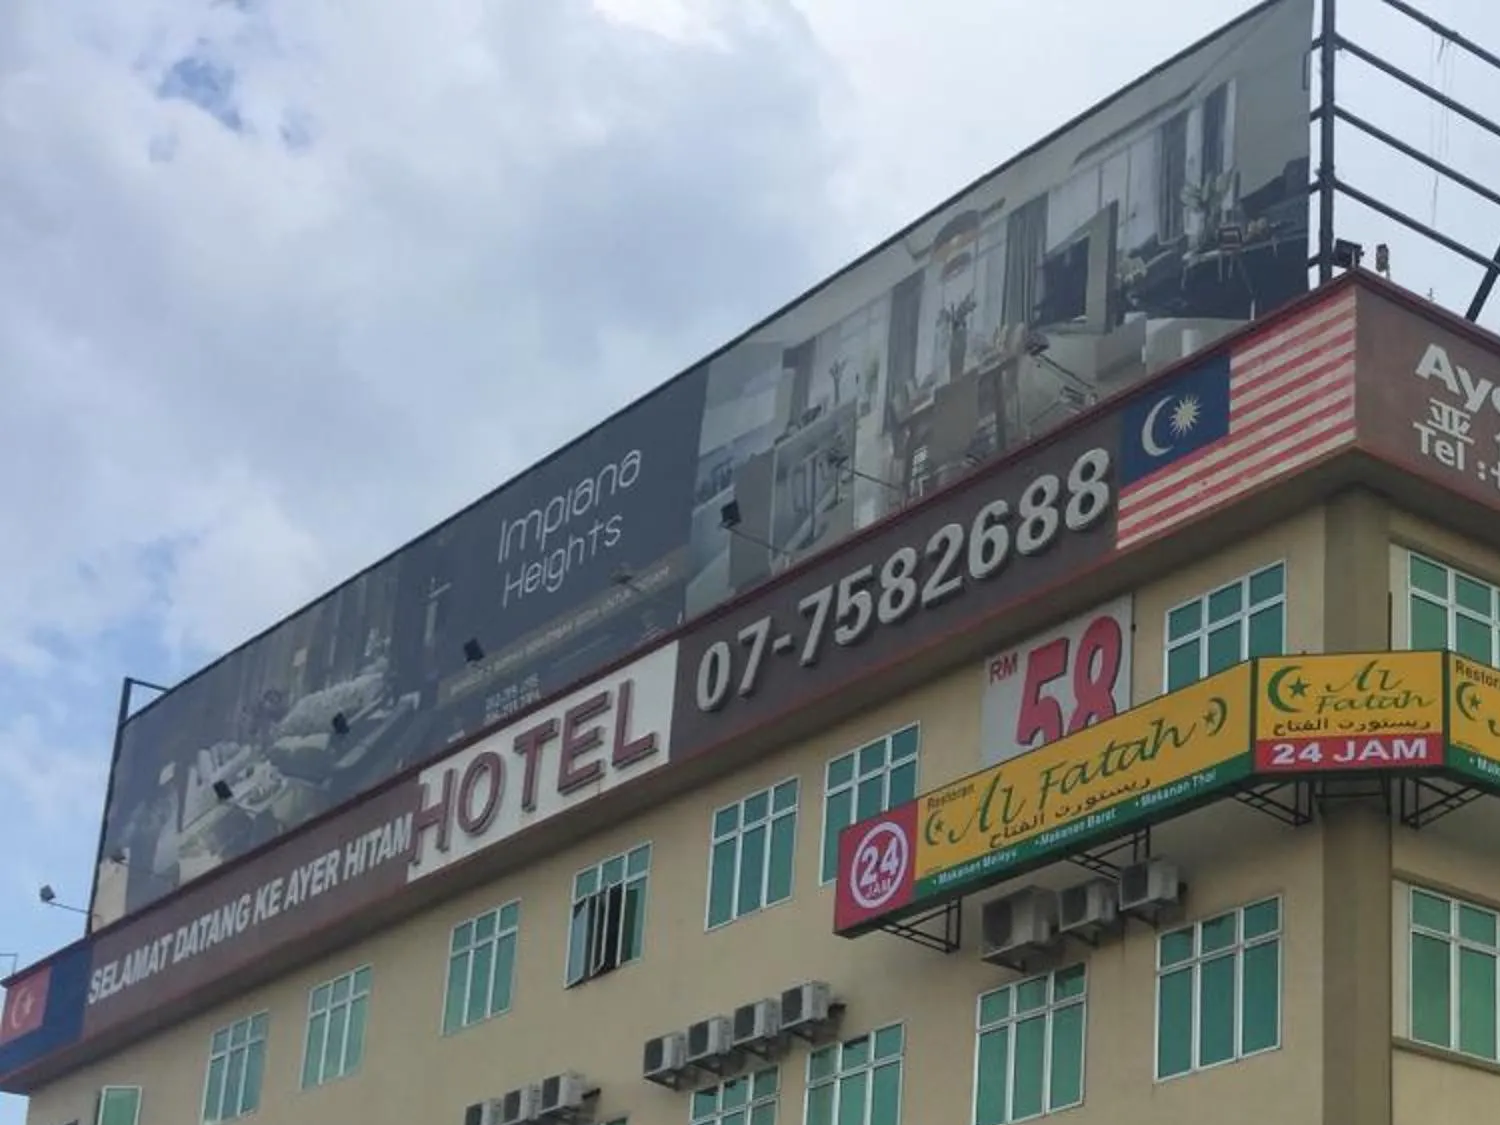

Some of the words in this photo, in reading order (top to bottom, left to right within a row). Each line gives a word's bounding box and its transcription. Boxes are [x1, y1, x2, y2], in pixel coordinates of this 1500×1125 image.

[1413, 421, 1465, 470] Tel
[498, 449, 641, 563] Impiana
[503, 515, 623, 608] Heights
[408, 679, 658, 866] HOTEL
[696, 447, 1110, 712] 07-7582688
[990, 653, 1017, 685] RM
[1017, 616, 1122, 746] 58
[949, 771, 1025, 843] Al
[1040, 718, 1196, 810] Fatah
[1192, 768, 1217, 787] Thai
[1272, 743, 1322, 764] 24
[1333, 738, 1427, 761] JAM
[88, 933, 173, 1003] SELAMAT
[173, 894, 252, 961] DATANG
[252, 877, 284, 925] KE
[284, 849, 340, 908] AYER
[343, 812, 413, 879] HITAM
[860, 837, 898, 888] 24
[866, 878, 892, 899] JAM
